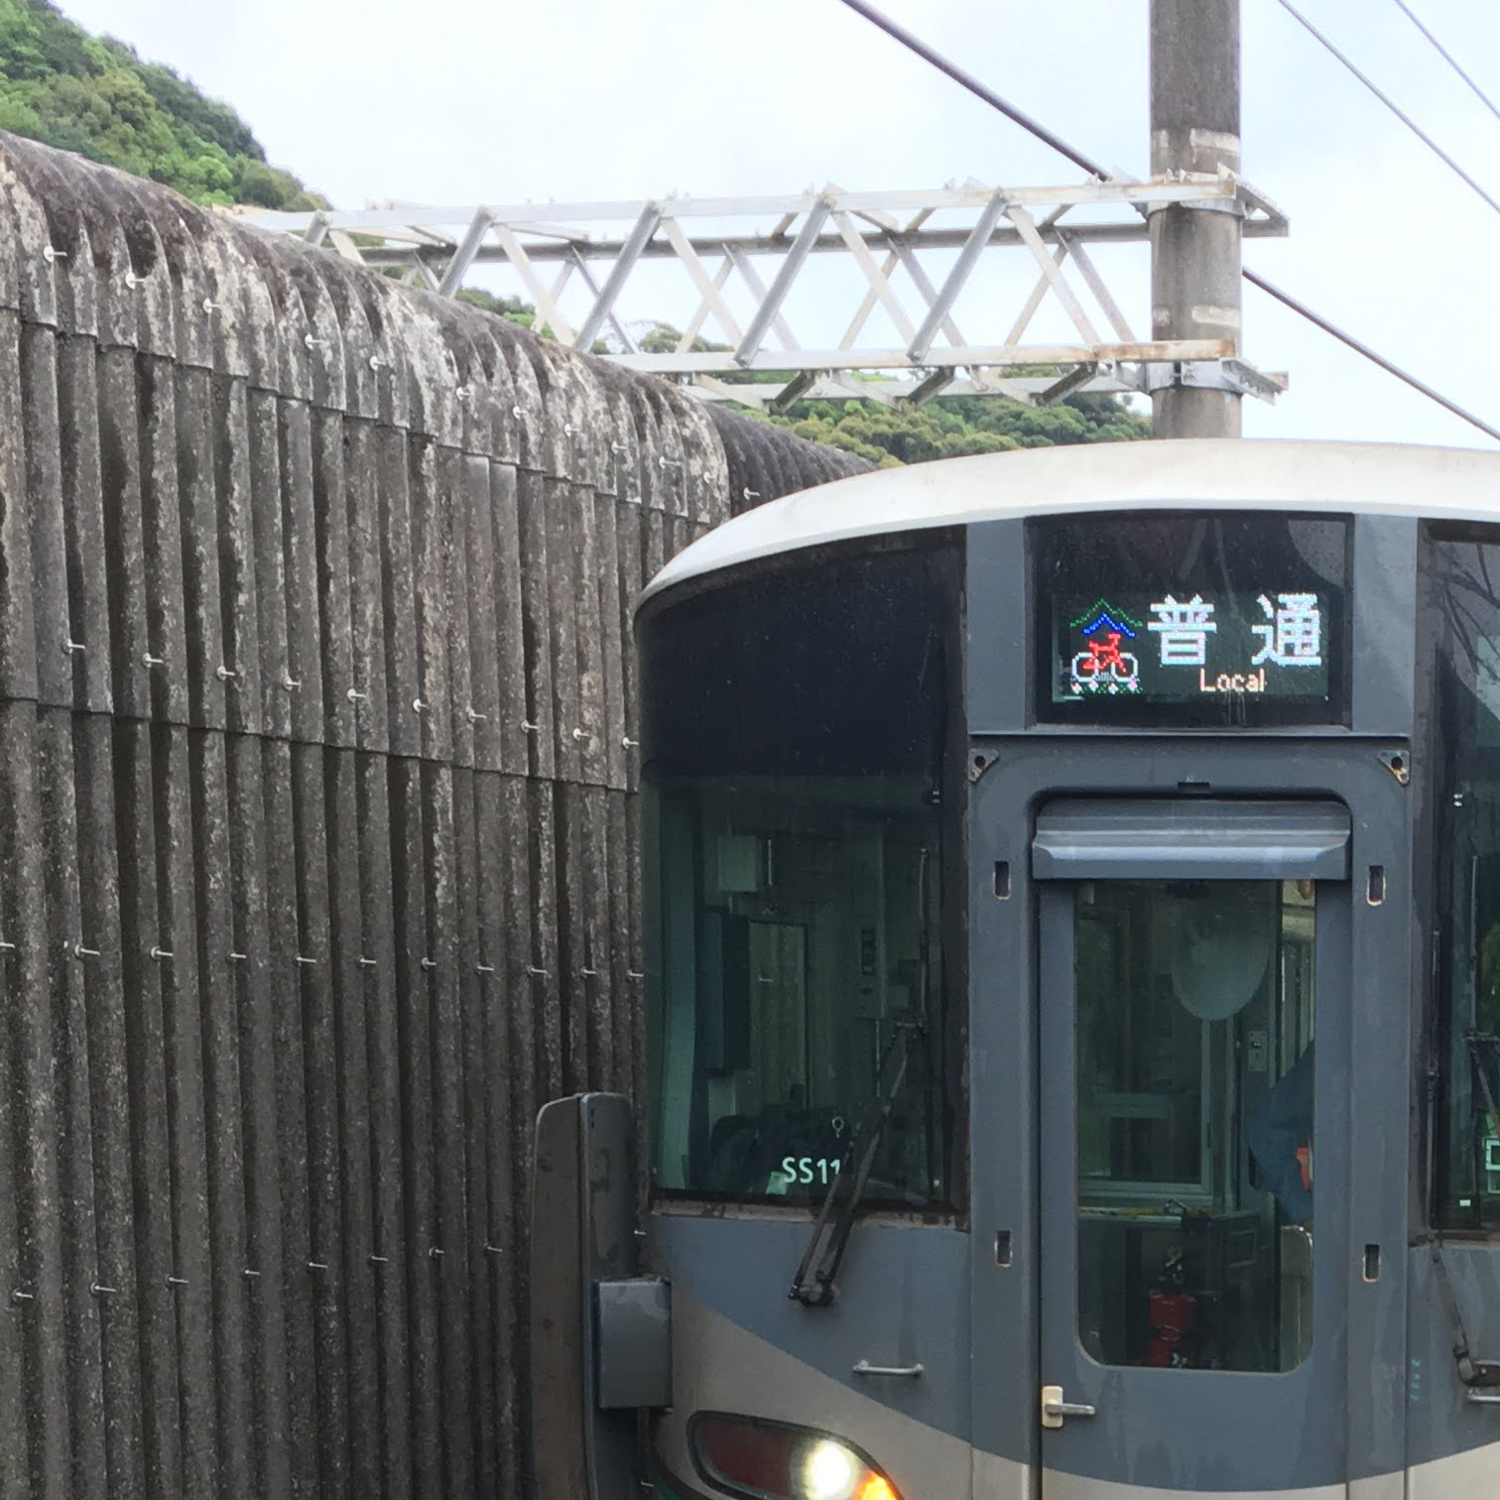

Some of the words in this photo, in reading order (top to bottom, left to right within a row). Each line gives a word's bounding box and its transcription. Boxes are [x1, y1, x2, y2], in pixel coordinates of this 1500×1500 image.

[1147, 592, 1322, 667] 普通
[1199, 668, 1266, 693] Local
[781, 1156, 841, 1184] SS11
